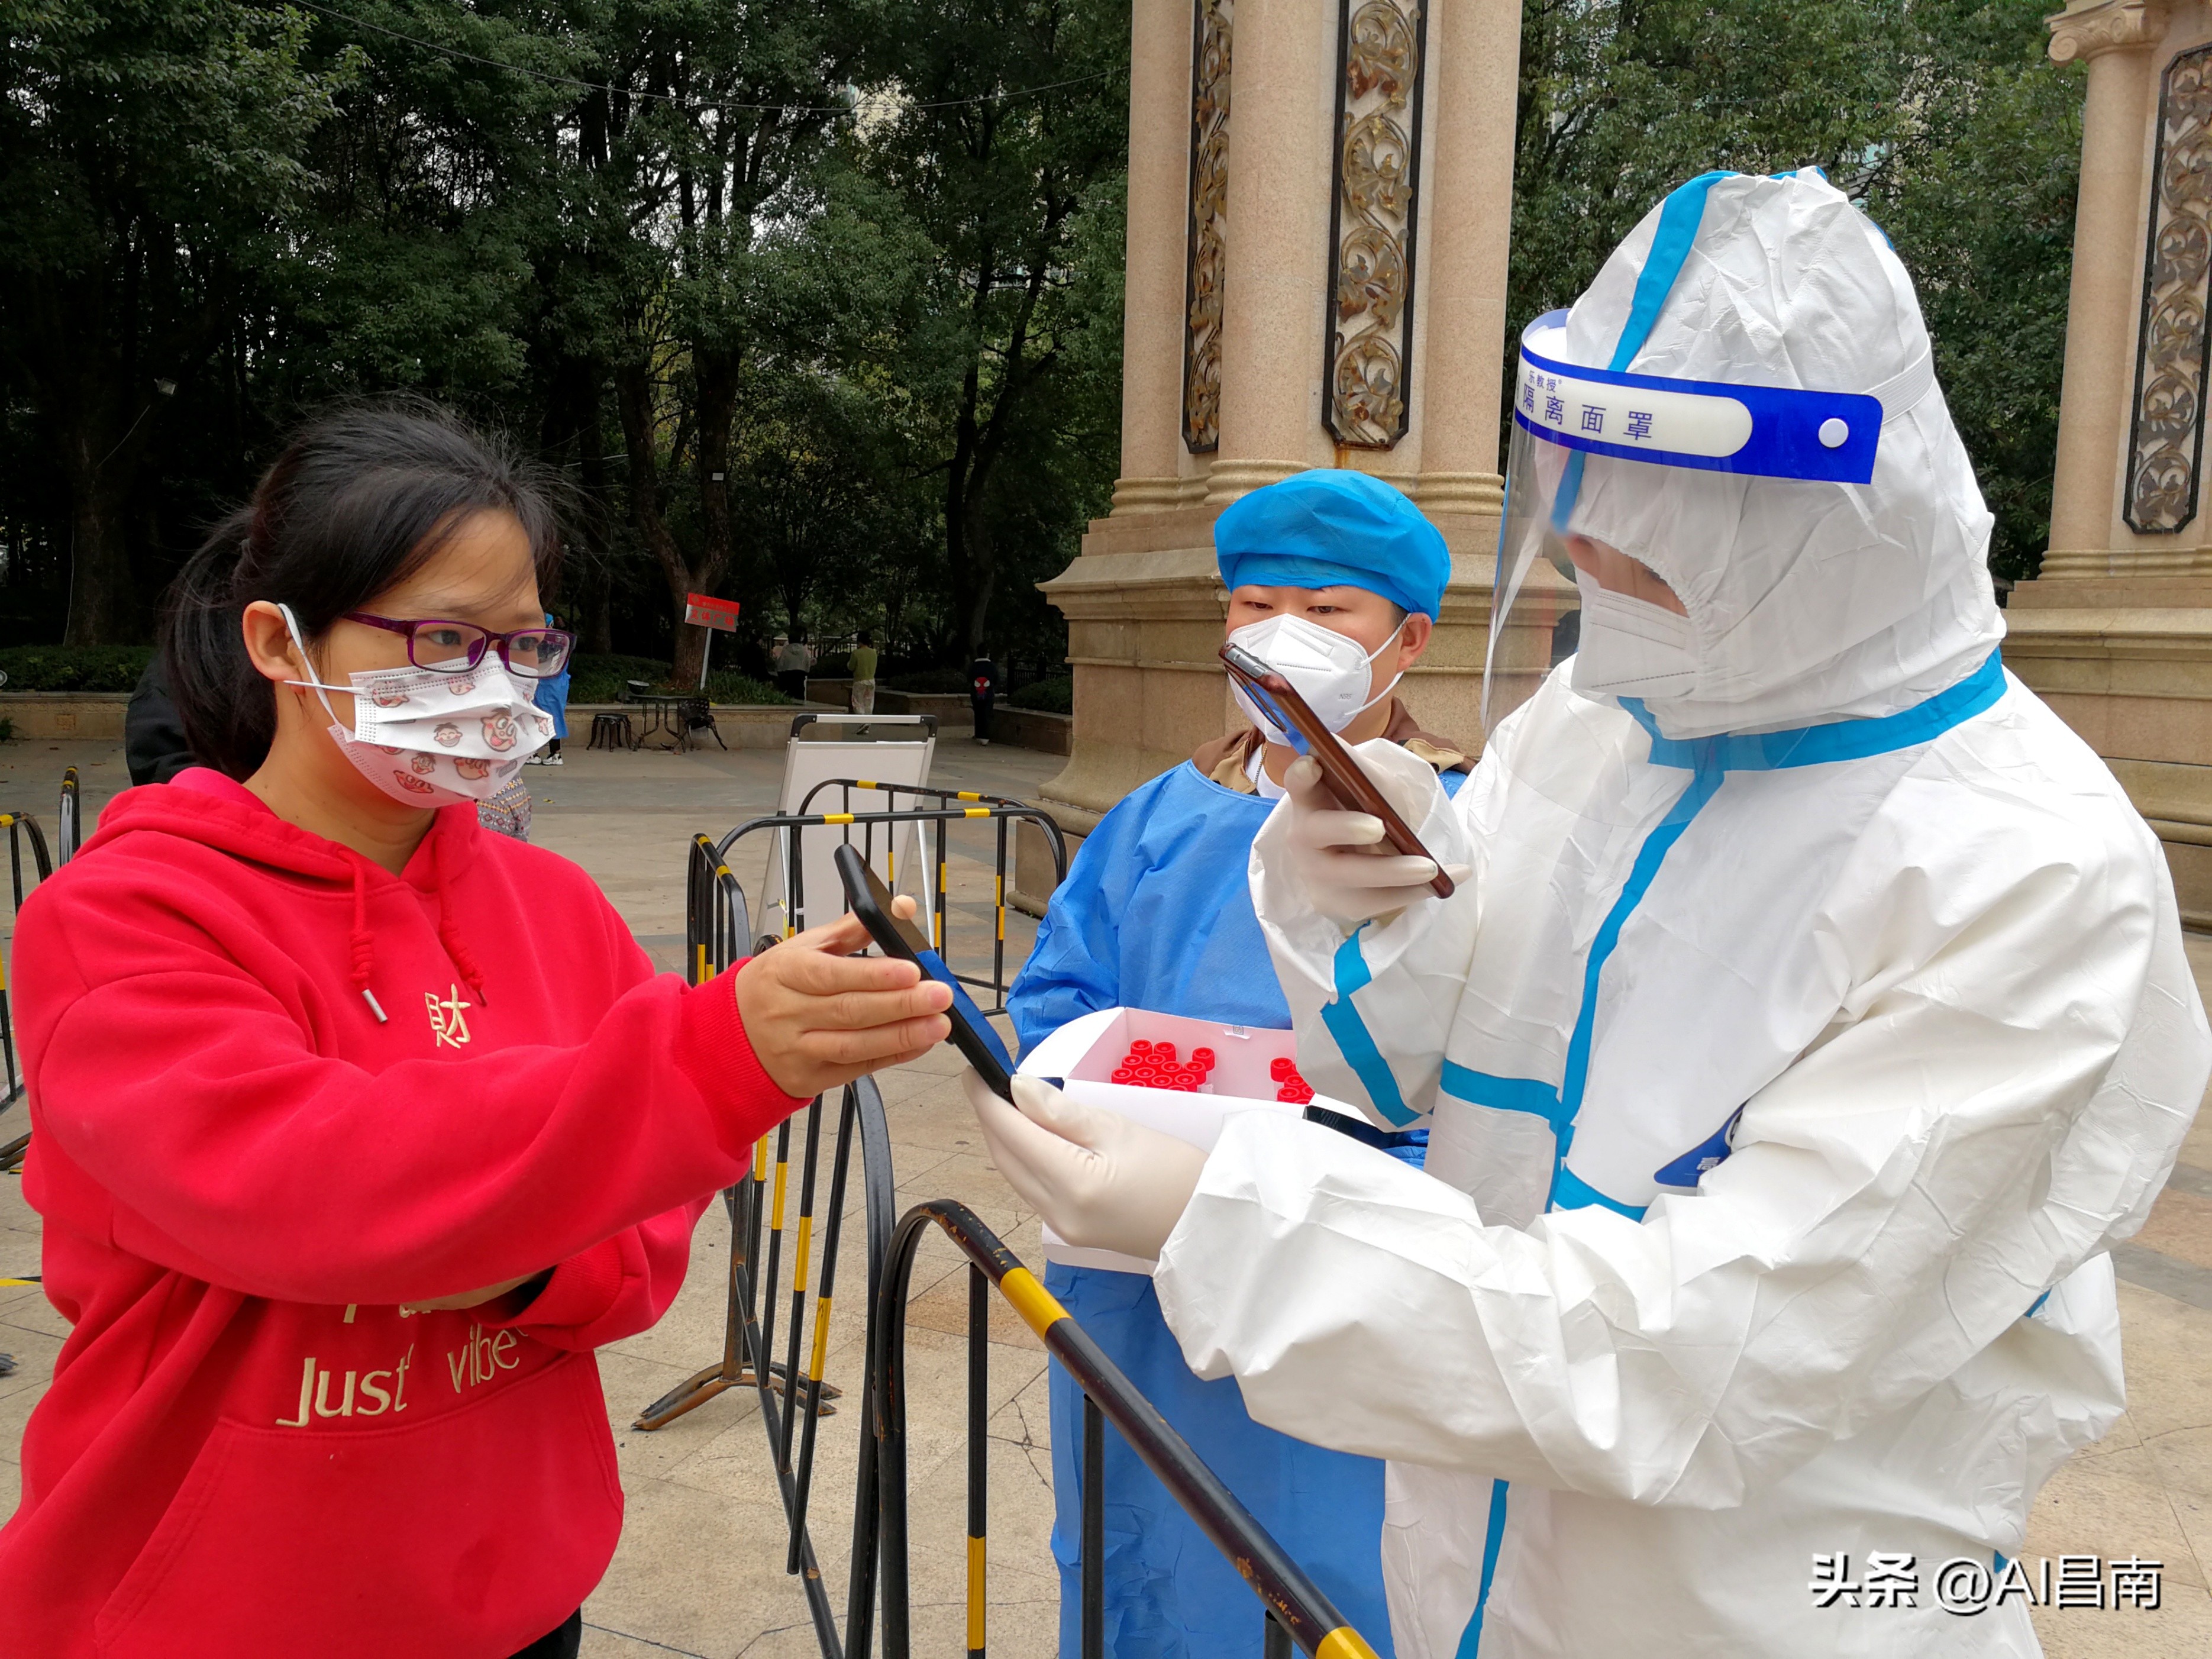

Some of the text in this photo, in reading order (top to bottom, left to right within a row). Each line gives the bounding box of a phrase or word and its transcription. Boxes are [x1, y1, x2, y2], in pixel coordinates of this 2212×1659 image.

[1529, 370, 1557, 393] 乐教授
[425, 983, 471, 1049] 財
[276, 1344, 414, 1428] Just
